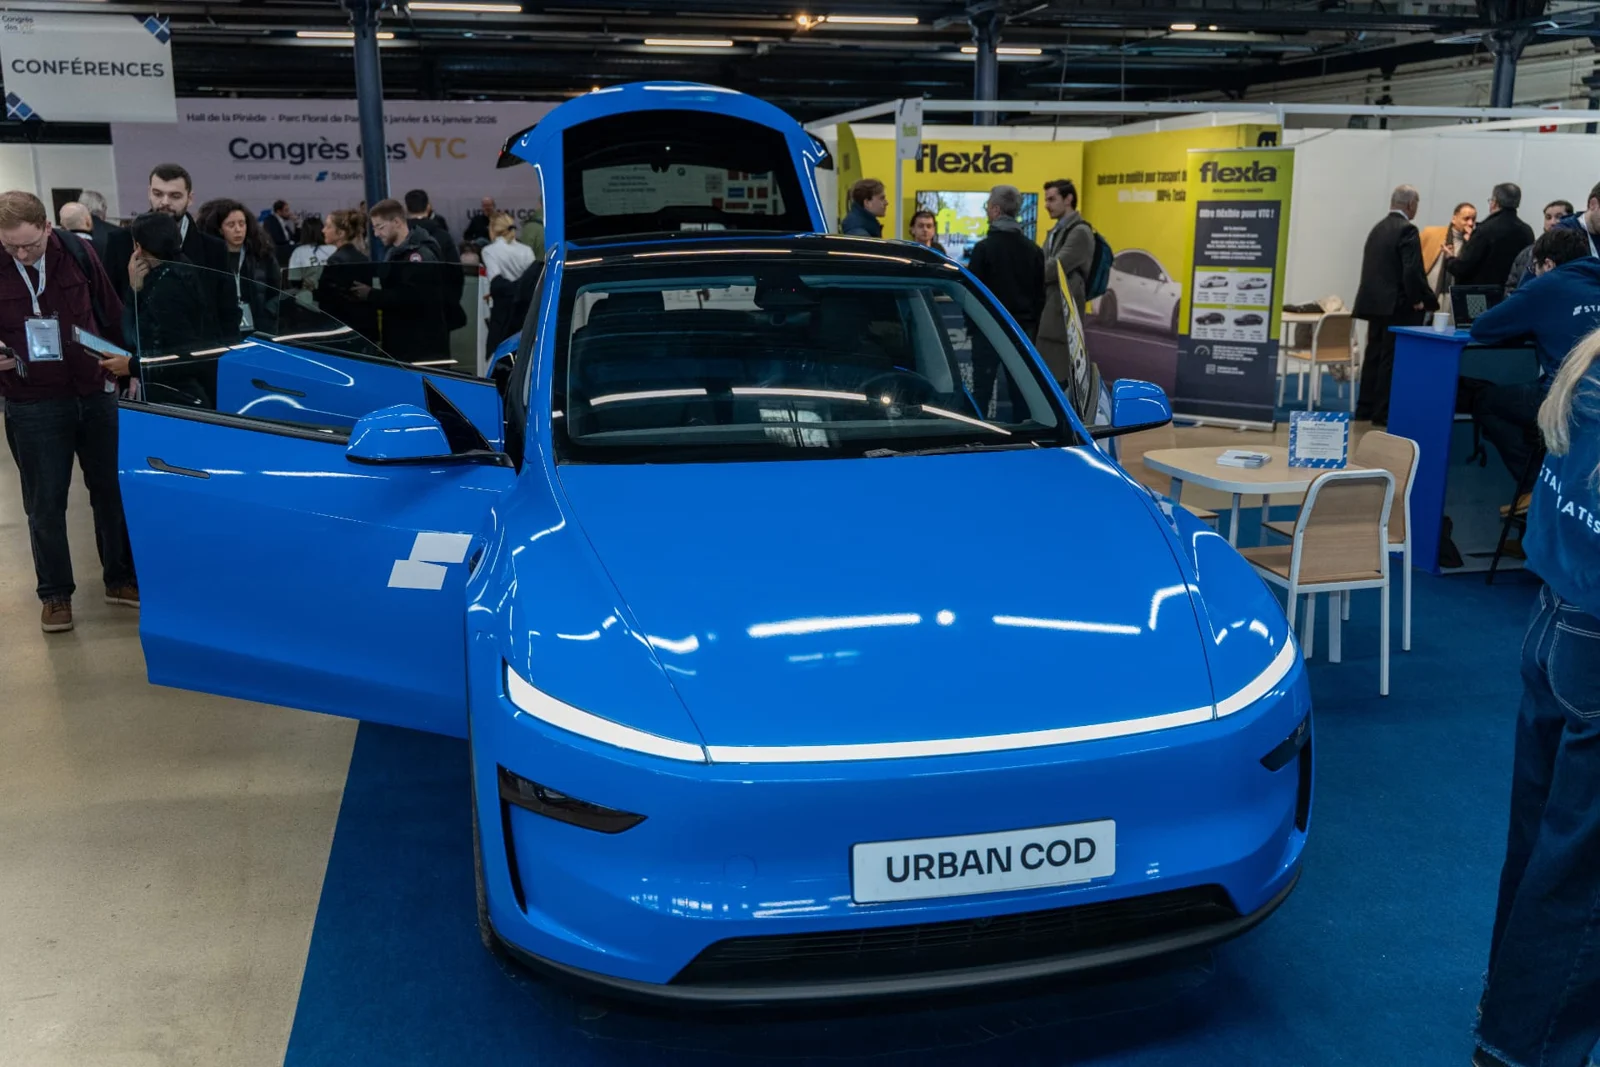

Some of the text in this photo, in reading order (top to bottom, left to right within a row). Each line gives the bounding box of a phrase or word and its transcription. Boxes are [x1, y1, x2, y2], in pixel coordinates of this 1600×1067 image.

[11, 57, 164, 77] CONFÉRENCES
[186, 113, 205, 122] Hall
[207, 113, 220, 122] de
[222, 113, 231, 122] la
[278, 114, 300, 122] Parc
[302, 113, 328, 123] Floral
[330, 114, 342, 122] de
[389, 114, 420, 124] janvier
[442, 114, 472, 125] janvier
[228, 136, 350, 165] Congrès
[886, 837, 1097, 883] URBAN COD
